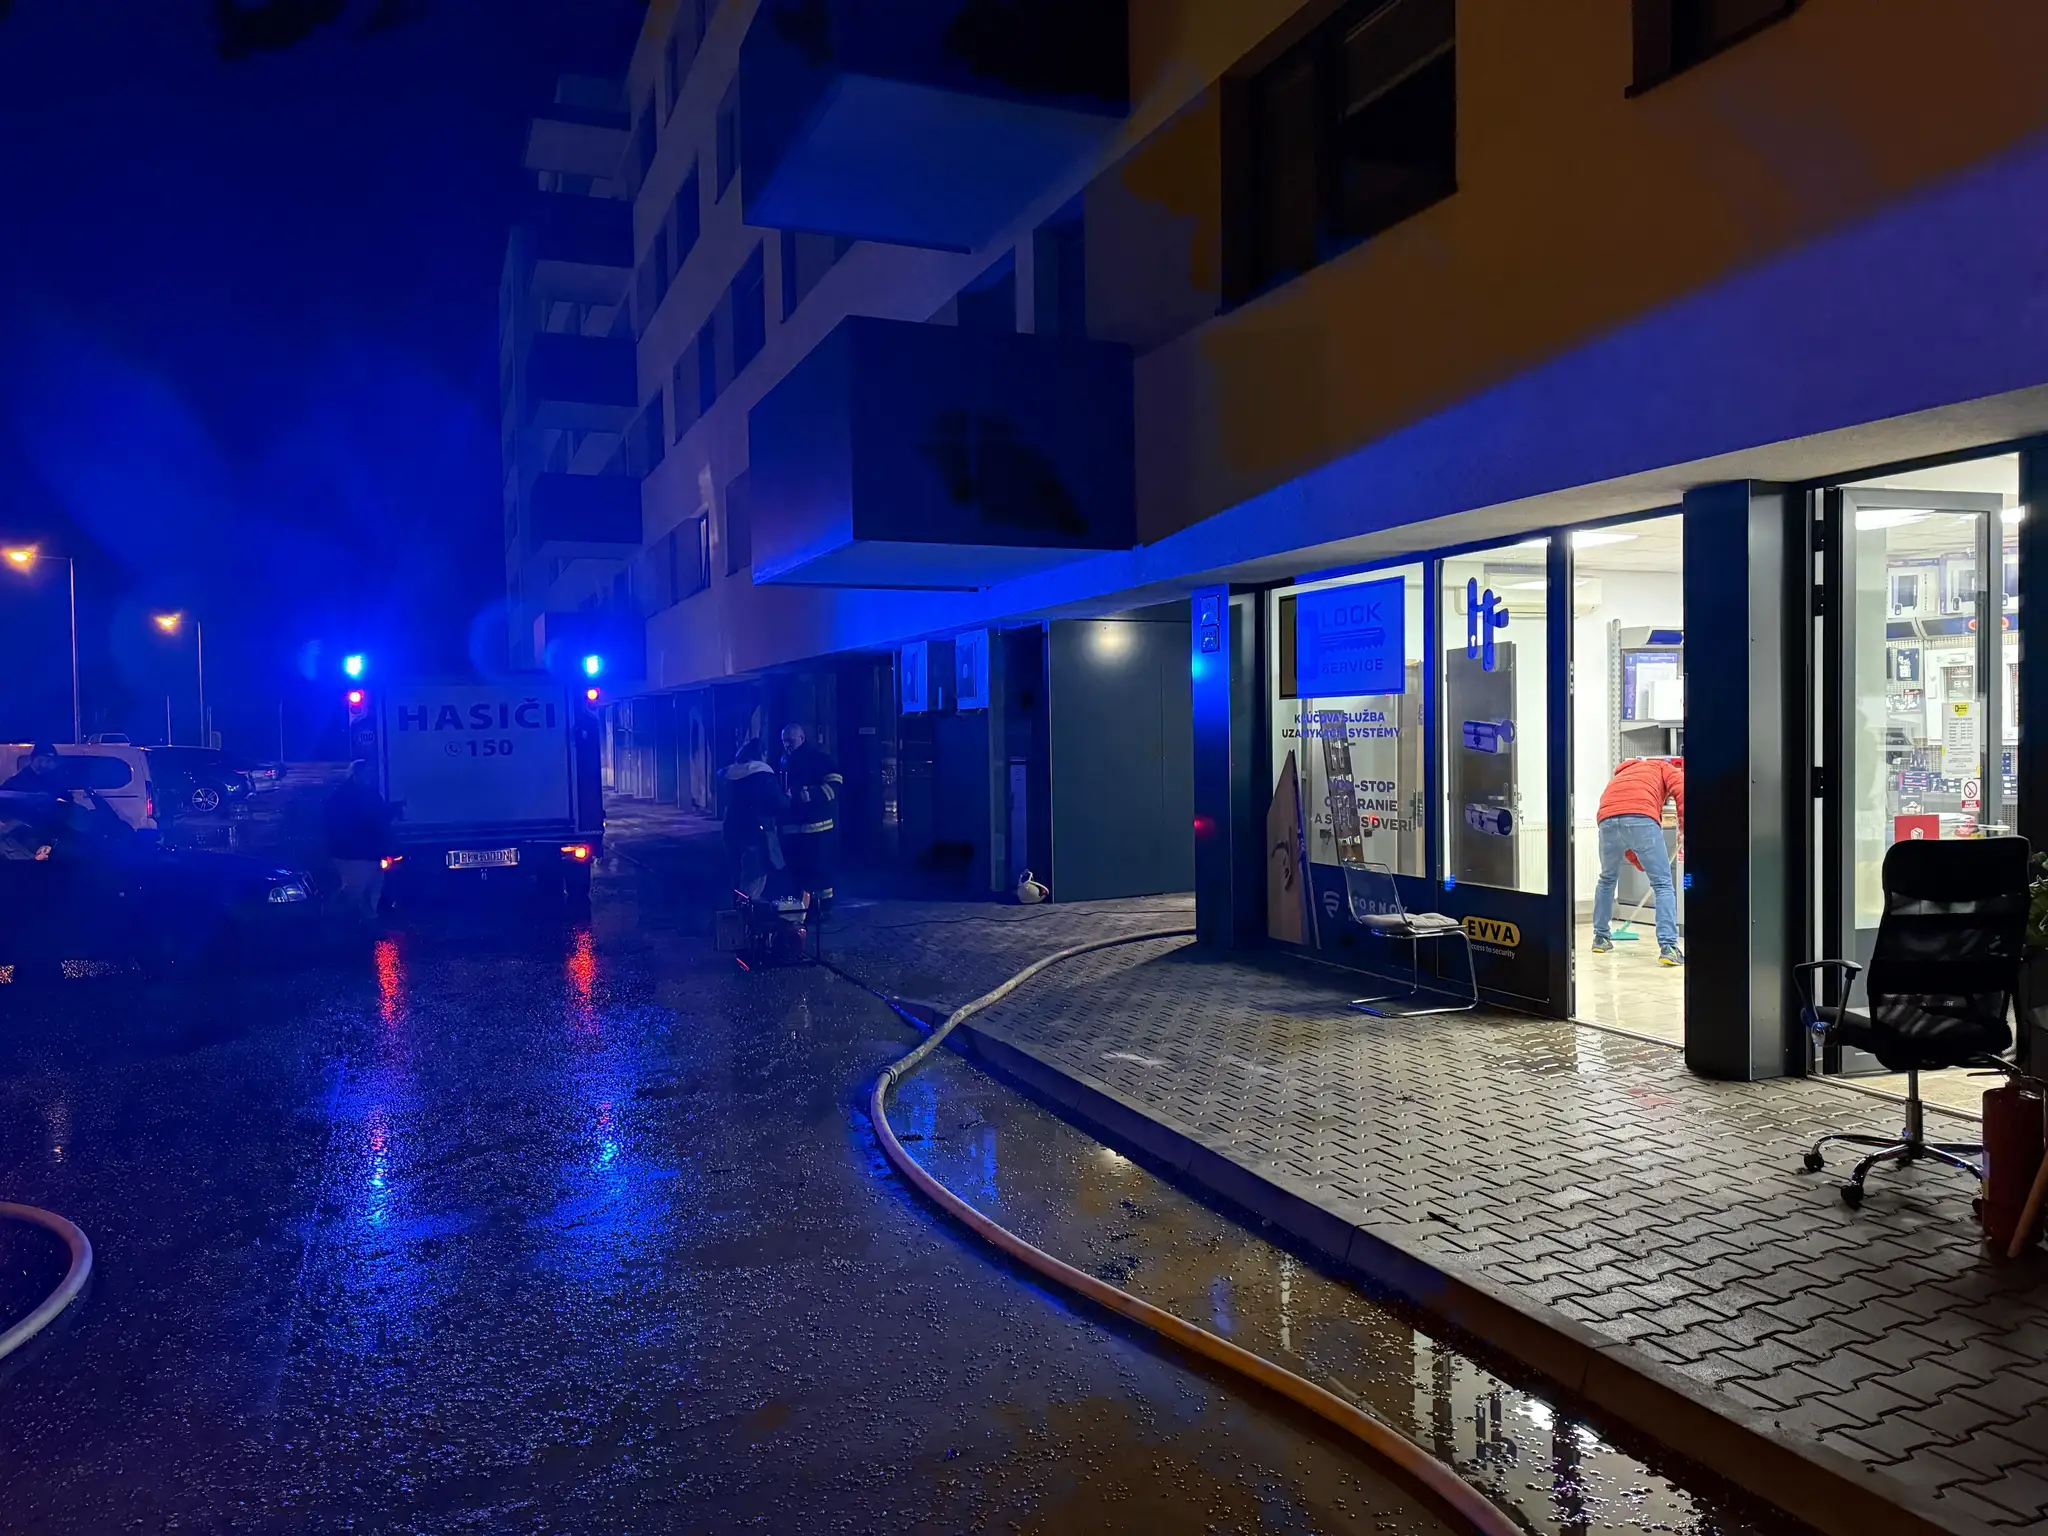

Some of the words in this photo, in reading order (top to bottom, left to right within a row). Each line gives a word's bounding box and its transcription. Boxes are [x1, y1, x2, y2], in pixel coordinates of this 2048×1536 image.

[1321, 601, 1384, 628] LOCK
[1321, 658, 1384, 675] SERVICE
[398, 697, 556, 732] HASIČI
[1341, 708, 1385, 723] SLUŽBA
[1348, 725, 1401, 738] SYSTÉMY
[466, 739, 514, 757] 150
[1324, 795, 1398, 812] ORANIE
[1314, 813, 1323, 824] A
[1467, 919, 1515, 944] EVVA
[1492, 948, 1516, 960] security
